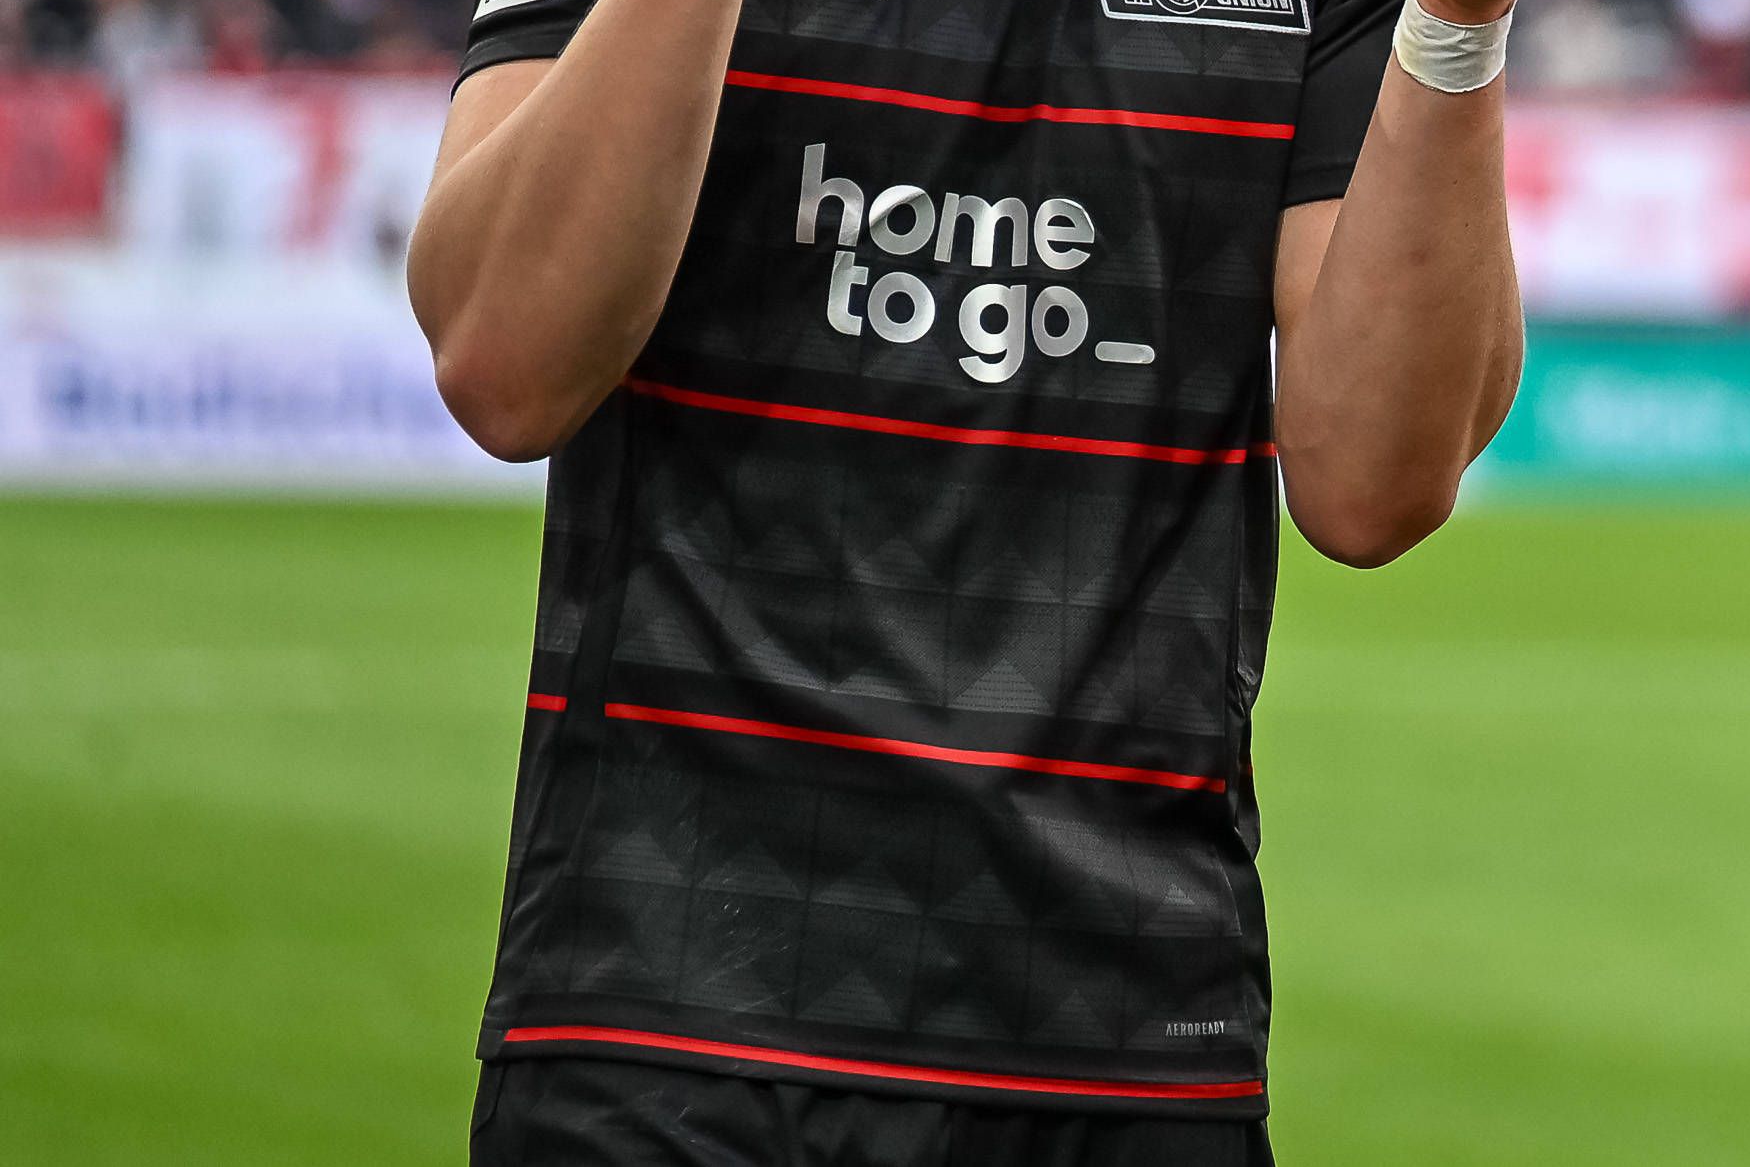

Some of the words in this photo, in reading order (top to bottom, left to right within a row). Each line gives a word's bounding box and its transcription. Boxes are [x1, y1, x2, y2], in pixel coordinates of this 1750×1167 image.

[795, 143, 1095, 270] home
[827, 250, 936, 343] to
[1165, 1020, 1225, 1036] AEROREADY
